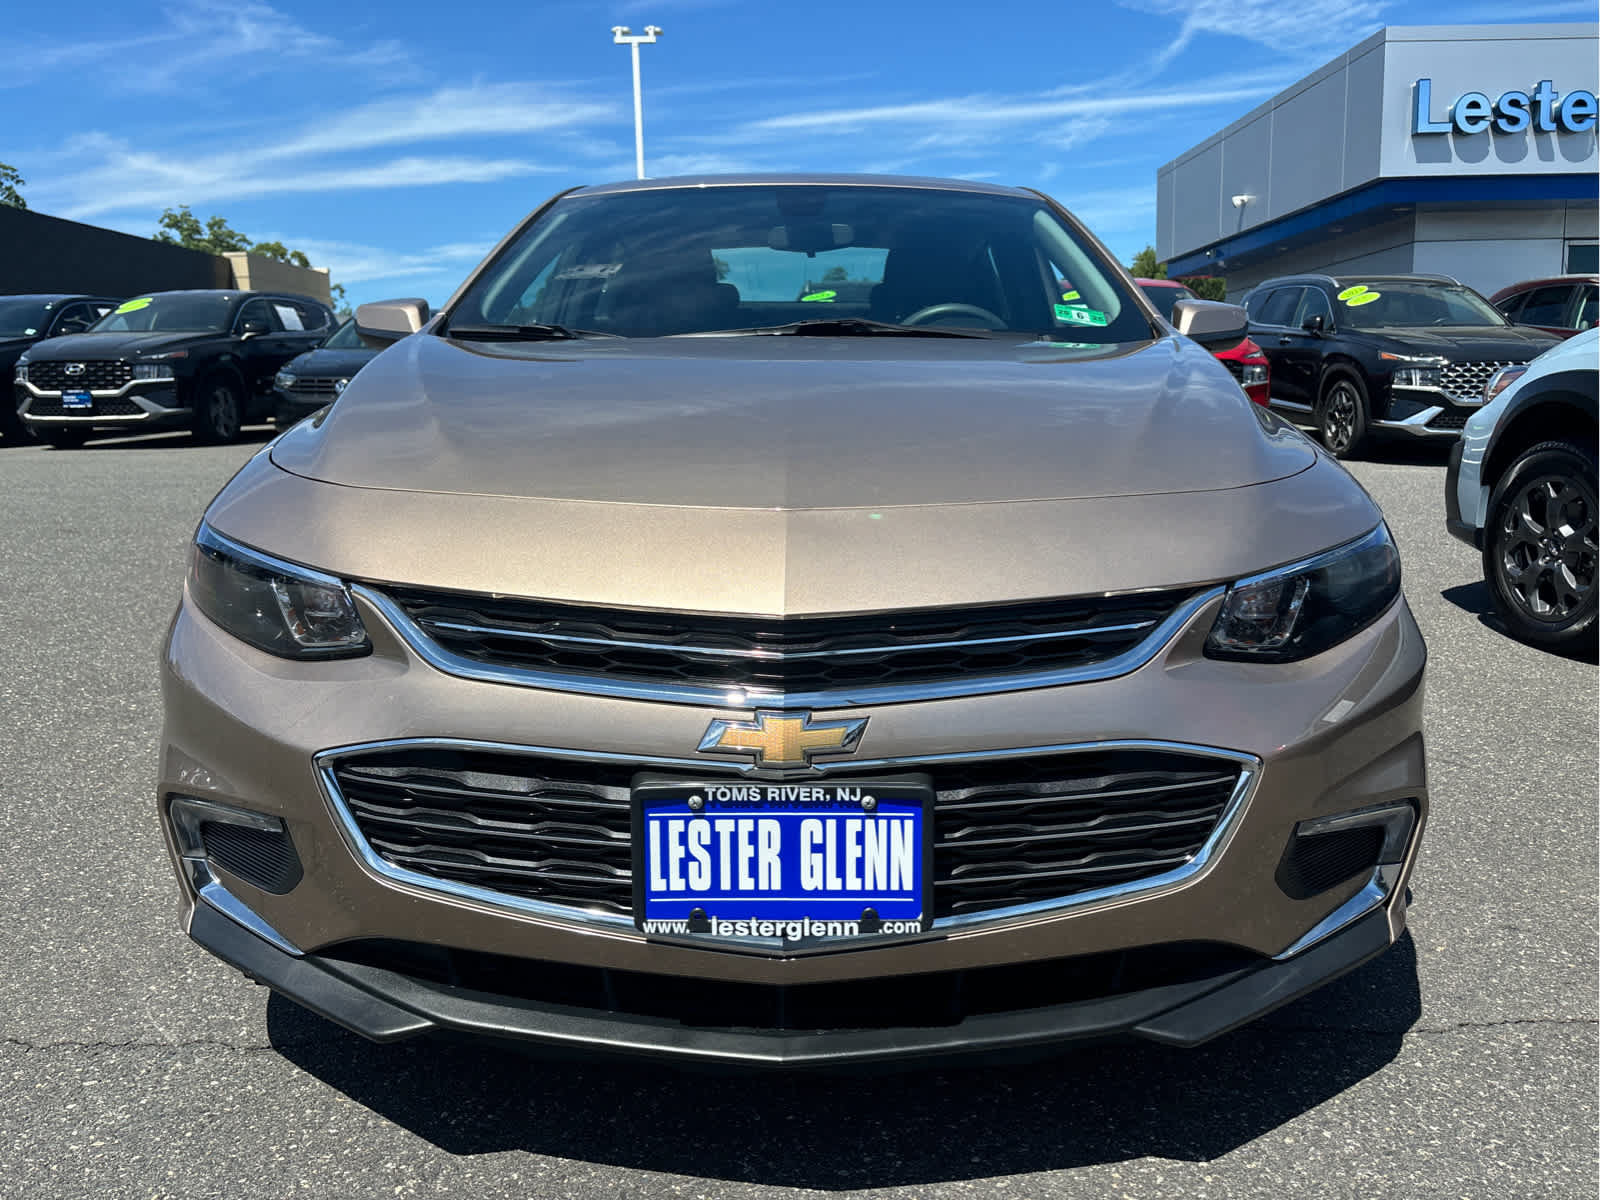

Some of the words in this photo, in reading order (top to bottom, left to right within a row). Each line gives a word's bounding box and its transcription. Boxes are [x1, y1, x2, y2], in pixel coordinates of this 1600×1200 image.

[1411, 78, 1598, 137] Leste
[1076, 312, 1085, 320] 6
[704, 787, 760, 802] TOMS
[767, 787, 831, 803] RIVER,
[836, 787, 861, 802] NJ
[649, 819, 782, 892] LESTER
[800, 818, 914, 891] GLENN
